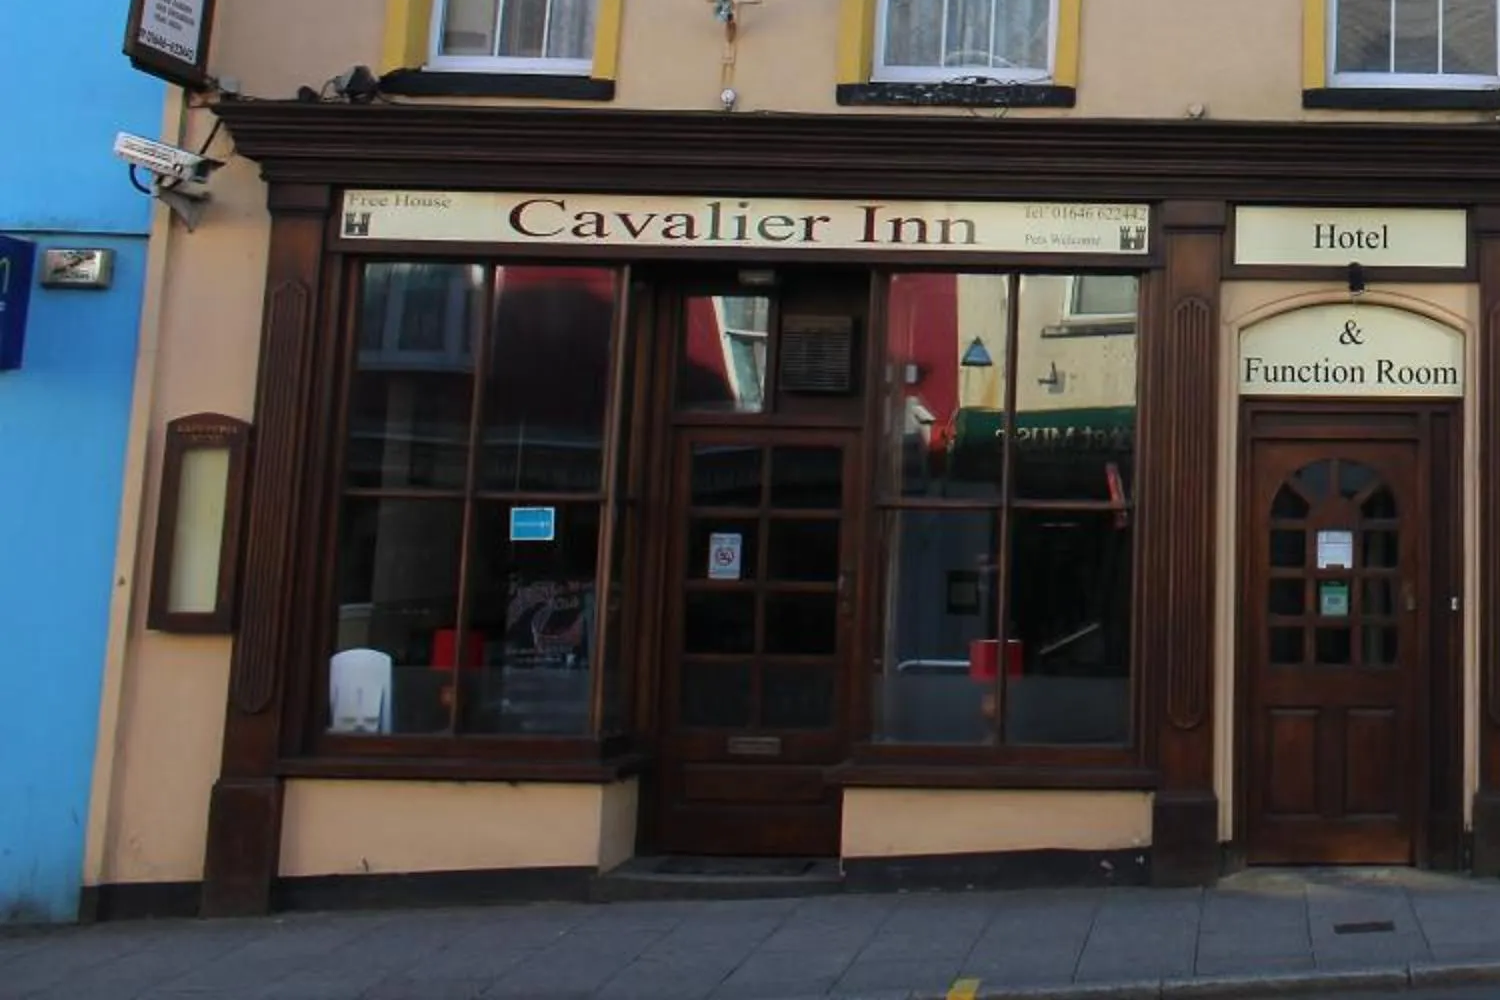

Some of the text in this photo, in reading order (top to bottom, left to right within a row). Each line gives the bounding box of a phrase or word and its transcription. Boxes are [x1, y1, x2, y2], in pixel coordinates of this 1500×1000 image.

[347, 194, 452, 209] Free House
[508, 198, 979, 246] Cavalier Inn
[1313, 224, 1389, 250] Hotel
[1338, 319, 1366, 346] &
[1244, 356, 1458, 385] Function Room
